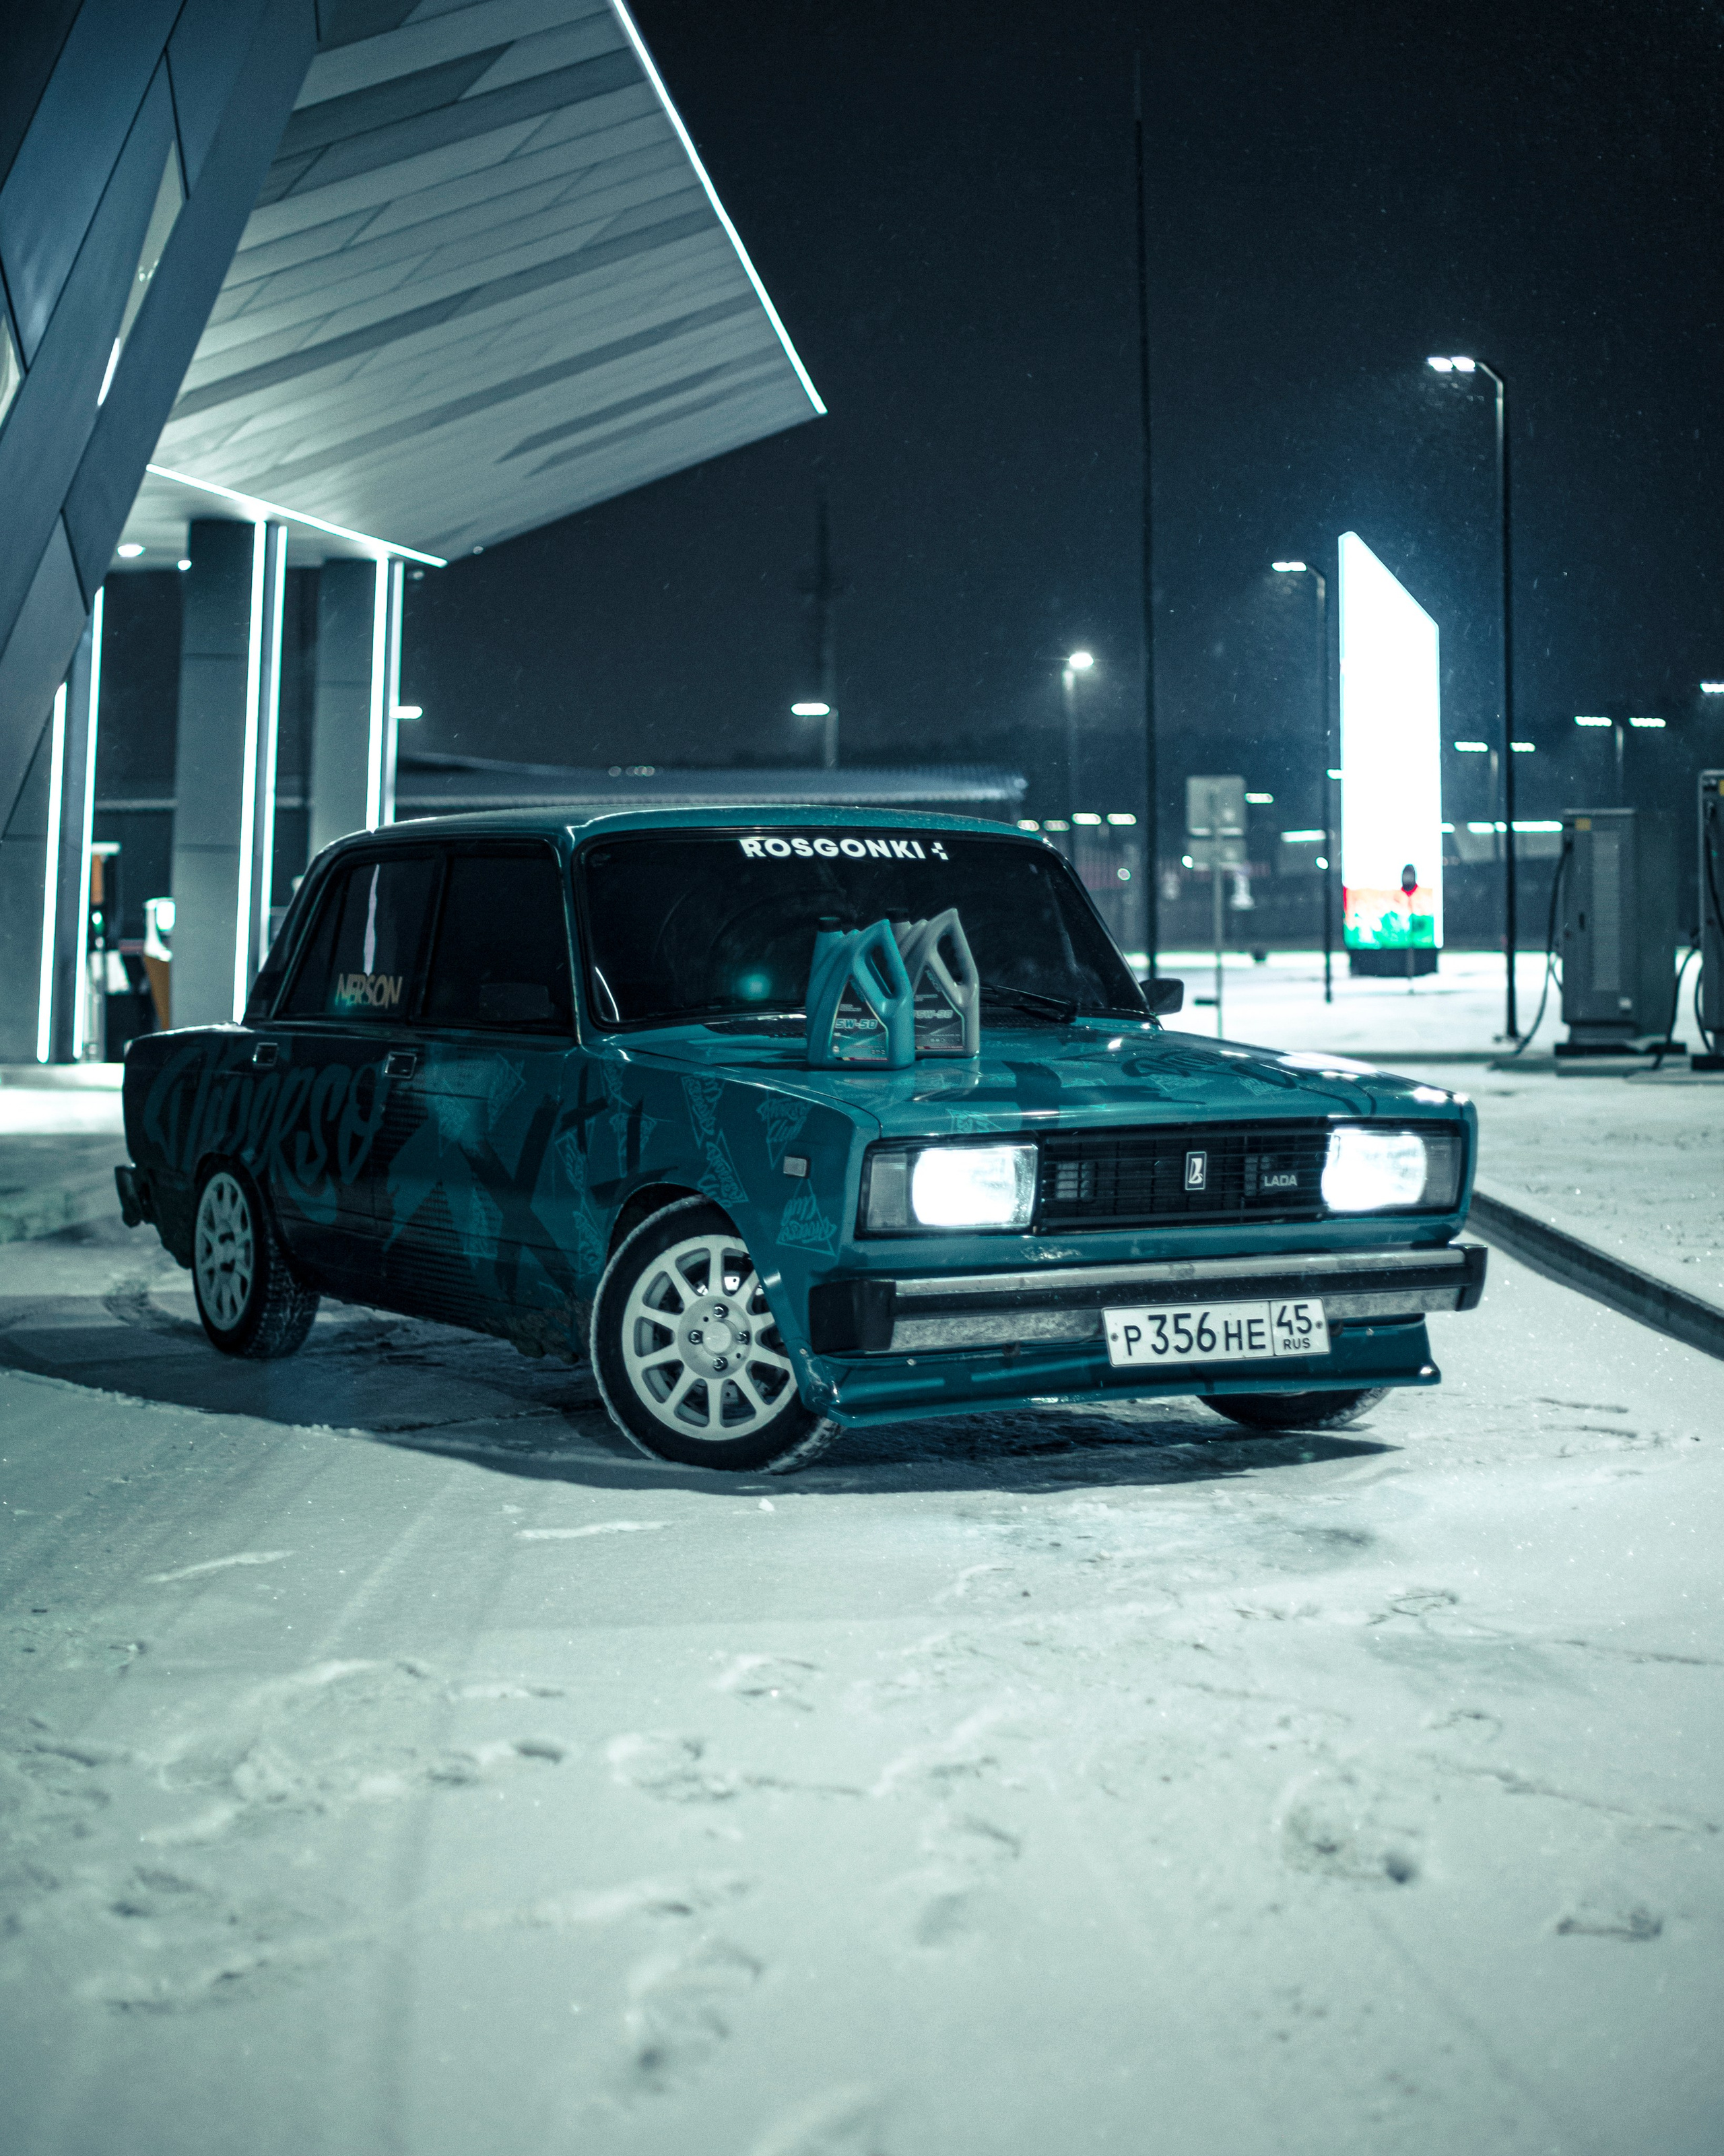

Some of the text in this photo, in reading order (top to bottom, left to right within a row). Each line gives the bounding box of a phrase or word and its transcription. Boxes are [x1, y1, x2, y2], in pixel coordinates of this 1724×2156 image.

[739, 838, 926, 859] ROSGONKI
[834, 1018, 877, 1029] 5W-50
[1264, 1175, 1298, 1188] LADA
[1275, 1304, 1313, 1335] 45
[1283, 1338, 1311, 1350] RUS
